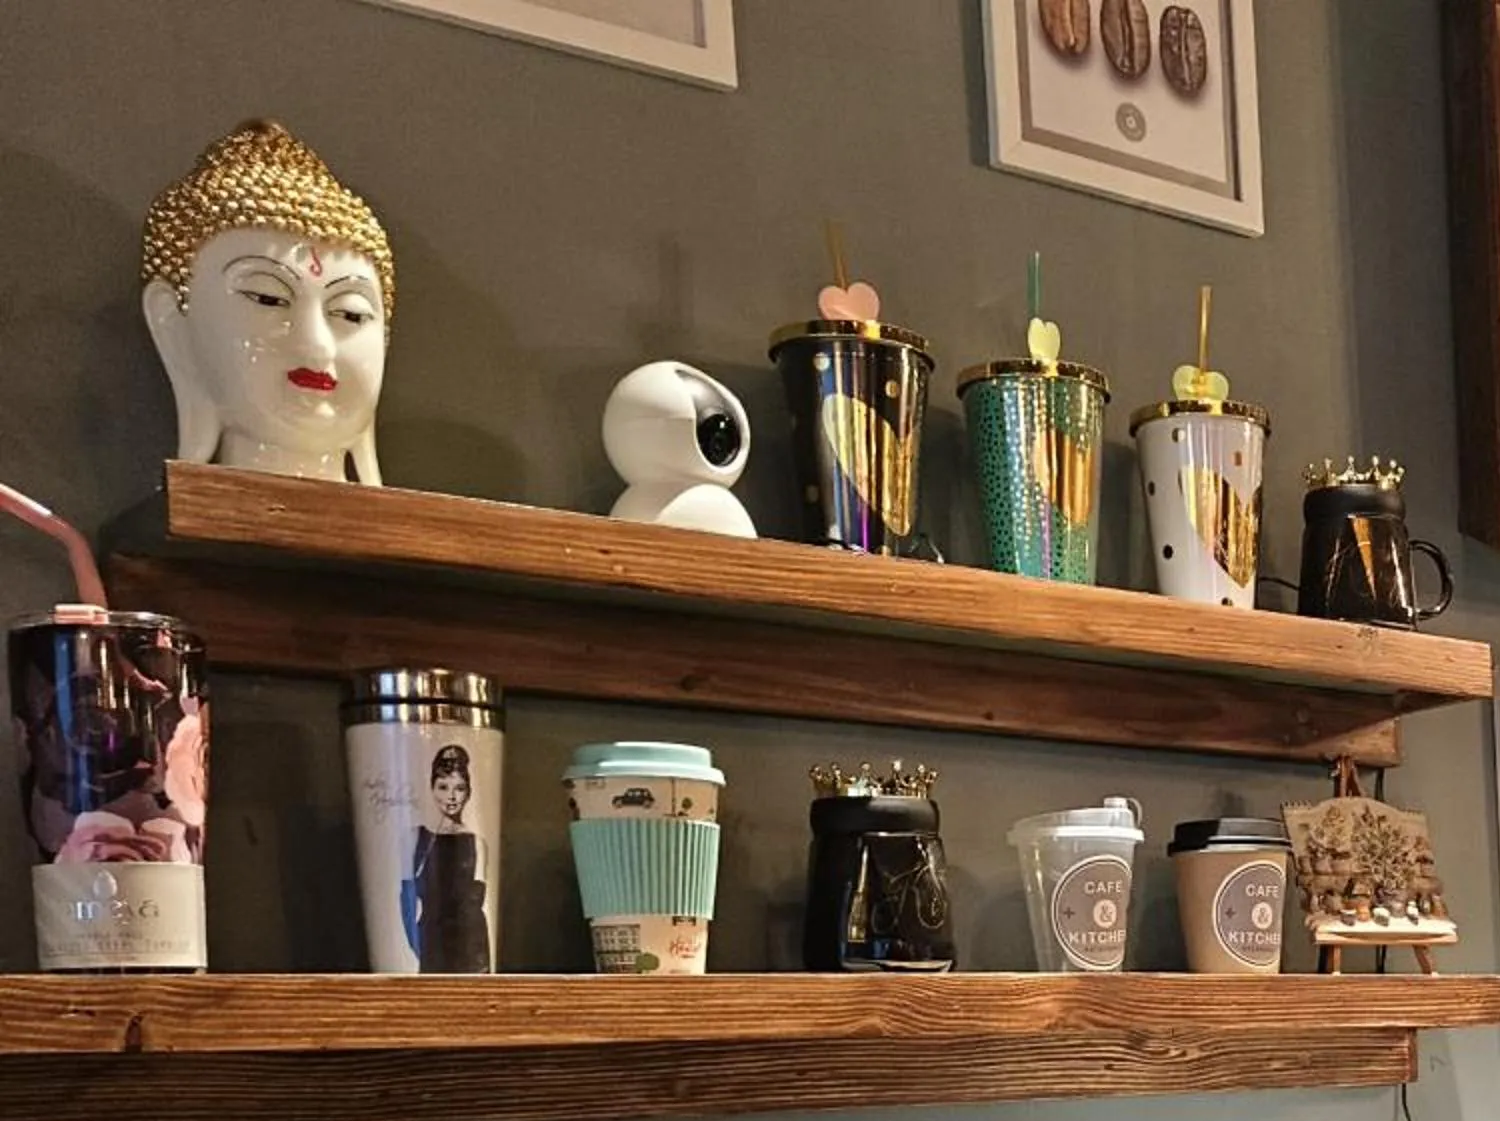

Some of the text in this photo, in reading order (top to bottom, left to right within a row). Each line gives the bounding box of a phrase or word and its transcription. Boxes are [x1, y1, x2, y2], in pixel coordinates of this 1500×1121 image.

[1245, 883, 1279, 898] CAFE
[1068, 929, 1126, 945] KITCHE
[1227, 931, 1281, 945] KITCHE
